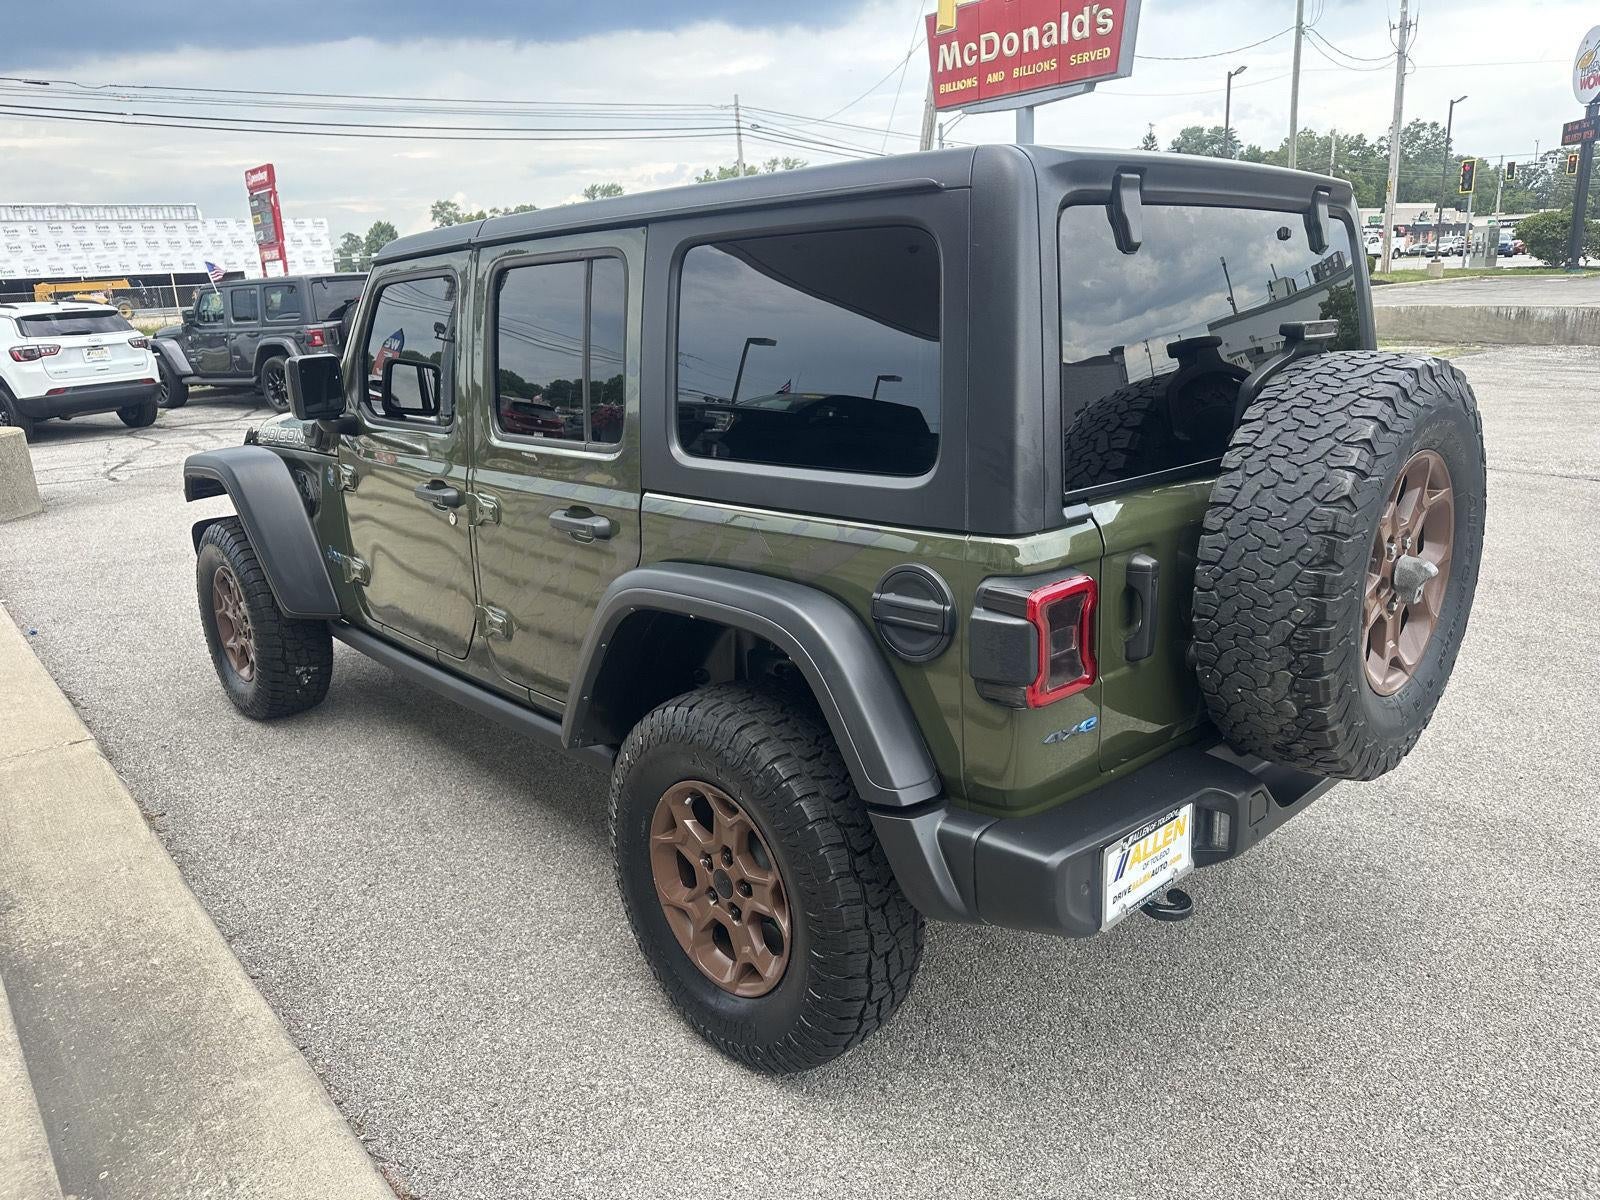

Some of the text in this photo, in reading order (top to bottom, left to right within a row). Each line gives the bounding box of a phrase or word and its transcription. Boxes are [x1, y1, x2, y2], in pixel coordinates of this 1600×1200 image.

[937, 4, 1114, 73] McDonald's
[939, 47, 1111, 94] BILLIONS AND BILLIONS SERVED
[1128, 814, 1187, 870] ALLEN
[1142, 848, 1170, 870] OF TOLEDO
